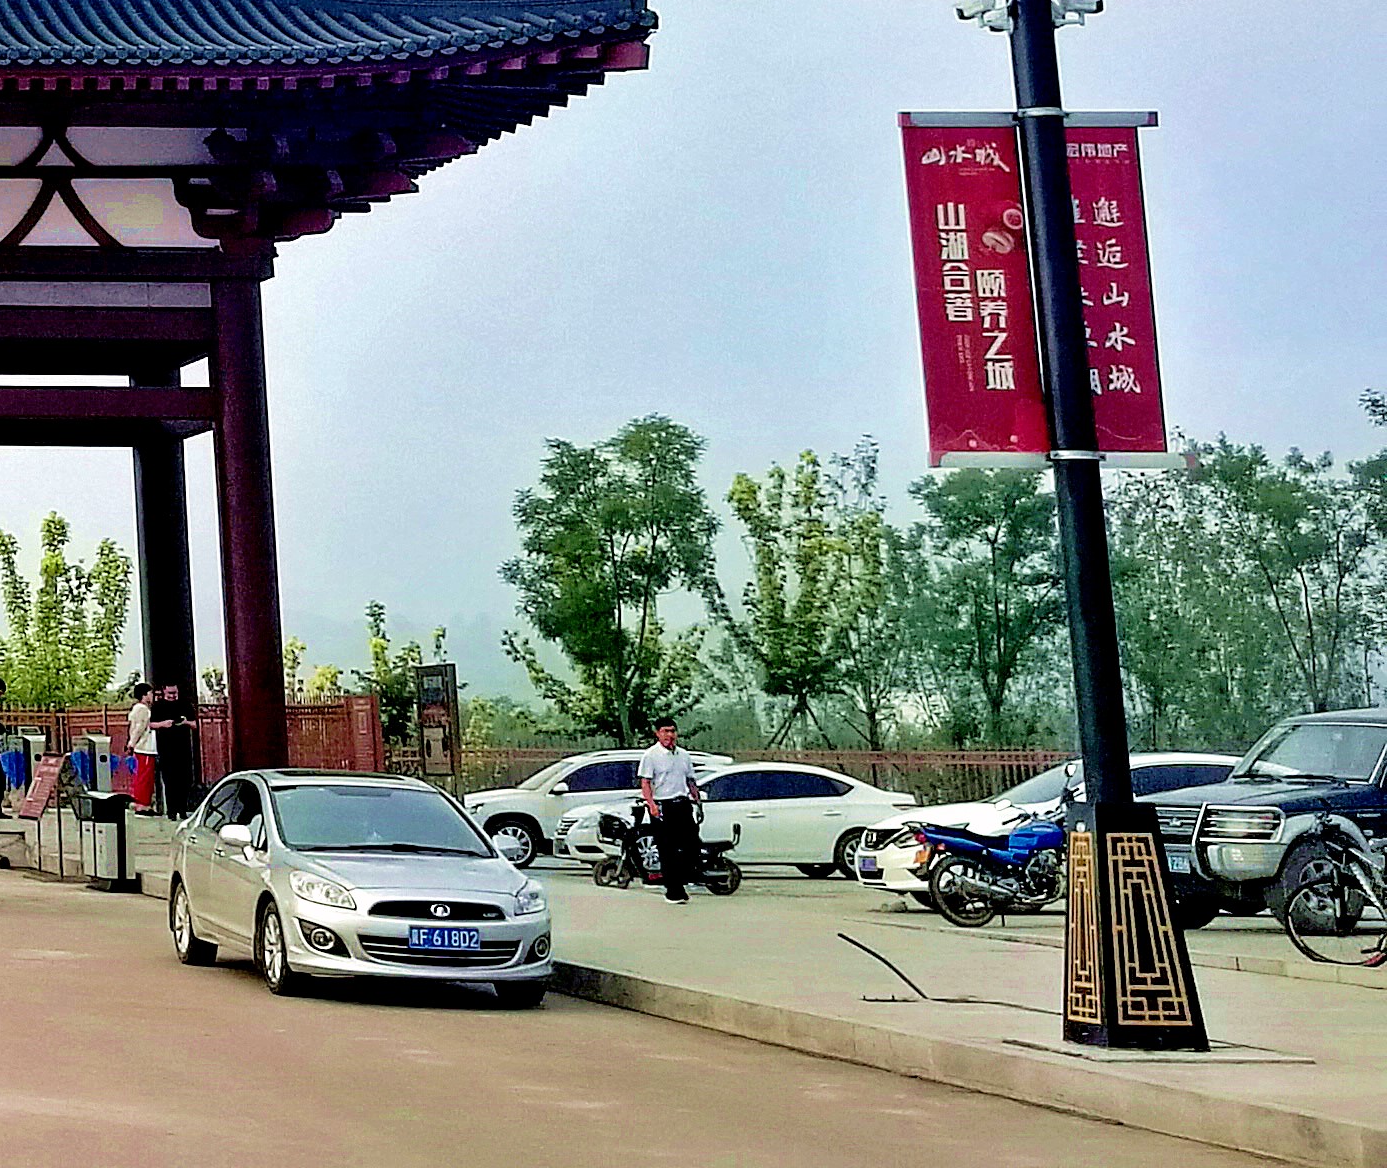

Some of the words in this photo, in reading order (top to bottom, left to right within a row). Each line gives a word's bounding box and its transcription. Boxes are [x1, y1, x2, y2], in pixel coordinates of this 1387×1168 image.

[976, 269, 1016, 391] 颐养之城
[1092, 197, 1141, 394] 邂逅山水城
